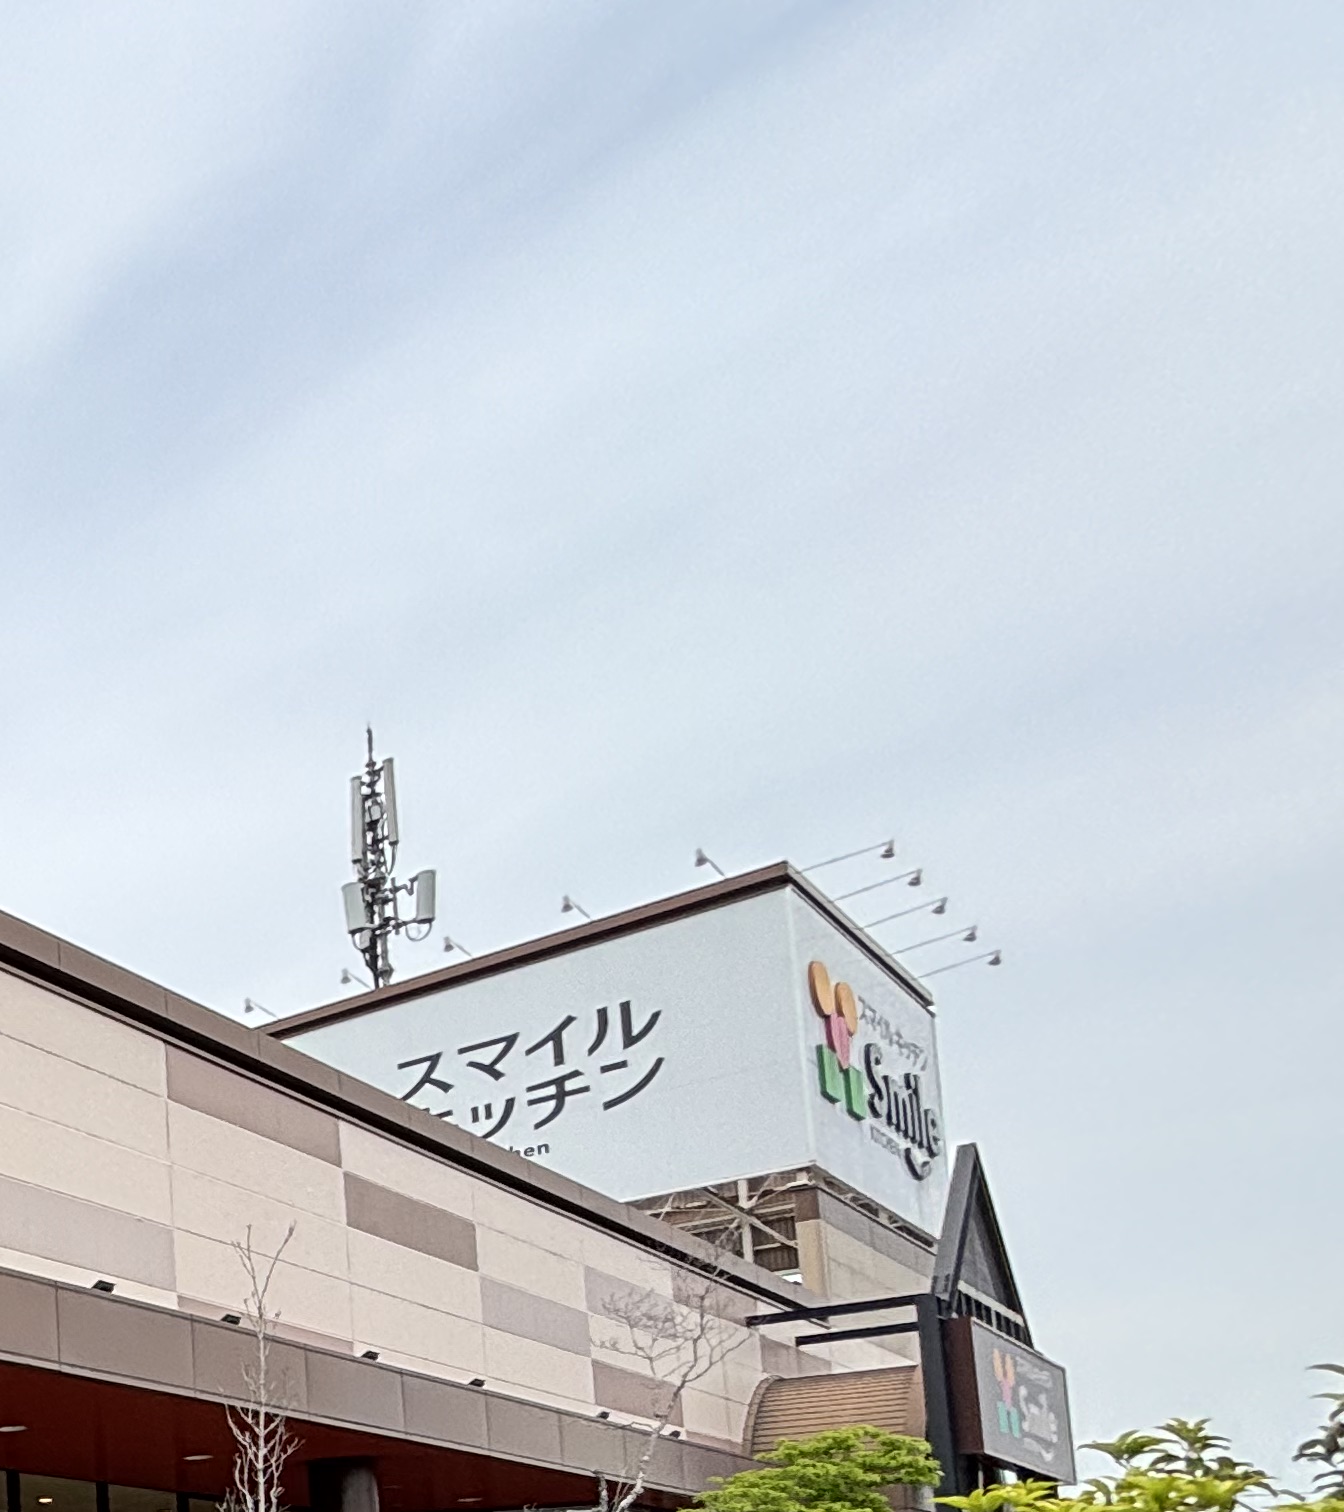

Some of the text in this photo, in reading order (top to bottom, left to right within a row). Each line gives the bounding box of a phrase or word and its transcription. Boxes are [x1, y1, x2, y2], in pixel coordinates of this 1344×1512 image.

[397, 1000, 661, 1101] スマイル
[423, 1057, 665, 1139] ッチン
[864, 1042, 941, 1159] Smile
